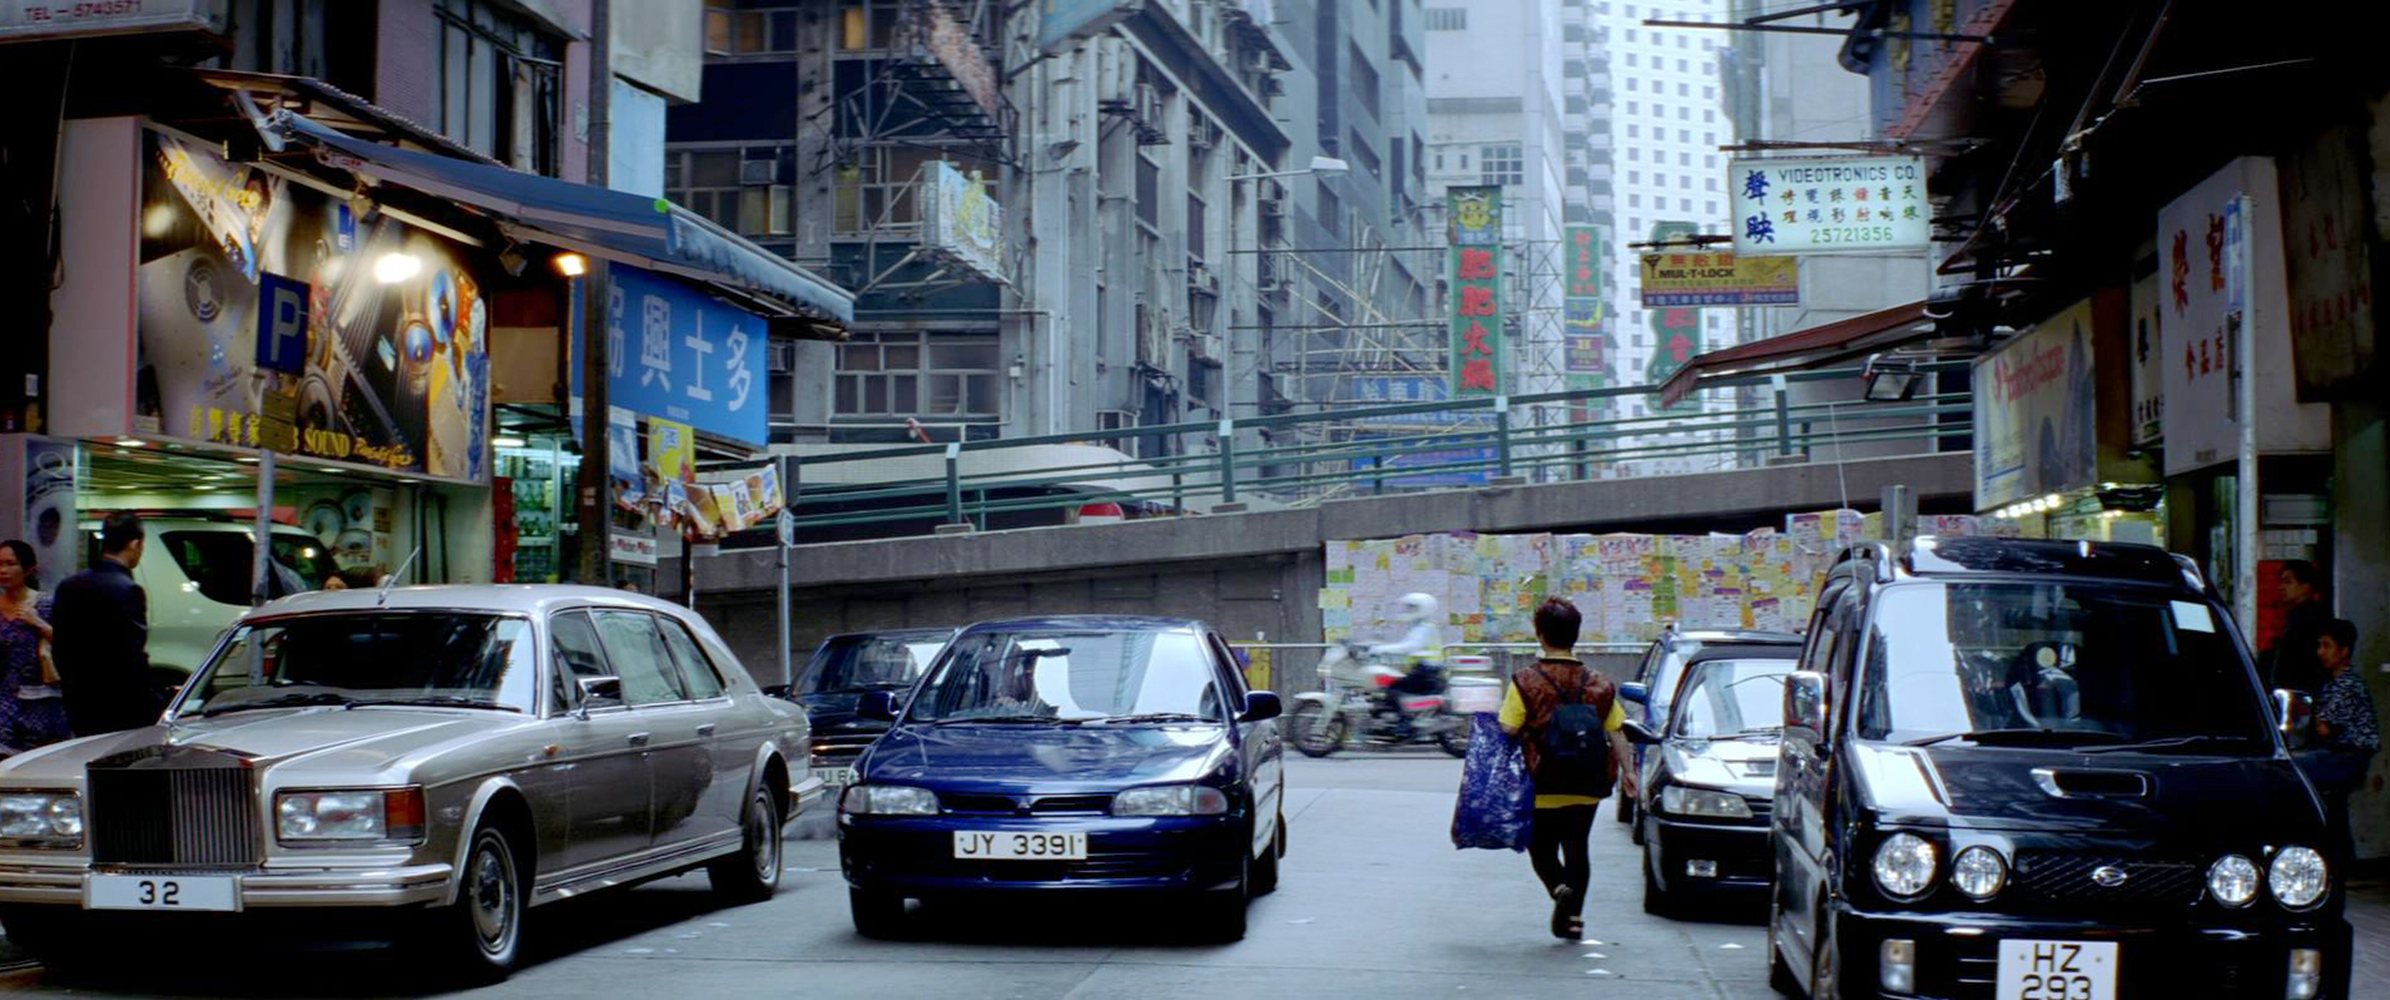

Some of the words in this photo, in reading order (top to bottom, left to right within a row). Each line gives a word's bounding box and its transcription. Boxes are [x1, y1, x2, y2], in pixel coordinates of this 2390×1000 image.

[25, 6, 52, 20] TEL
[1778, 166, 1888, 183] VIDEOTRONICS
[1894, 165, 1919, 181] CO.
[1742, 169, 1775, 244] 聲映
[1811, 226, 1893, 244] 25721356
[270, 286, 301, 363] P
[1457, 247, 1497, 392] 肥肥火鍋
[304, 427, 351, 458] SOUND
[962, 833, 995, 855] JY
[1013, 834, 1075, 856] 3391
[138, 880, 180, 905] 32
[2033, 943, 2082, 973] HZ
[2021, 974, 2092, 1000] 293
